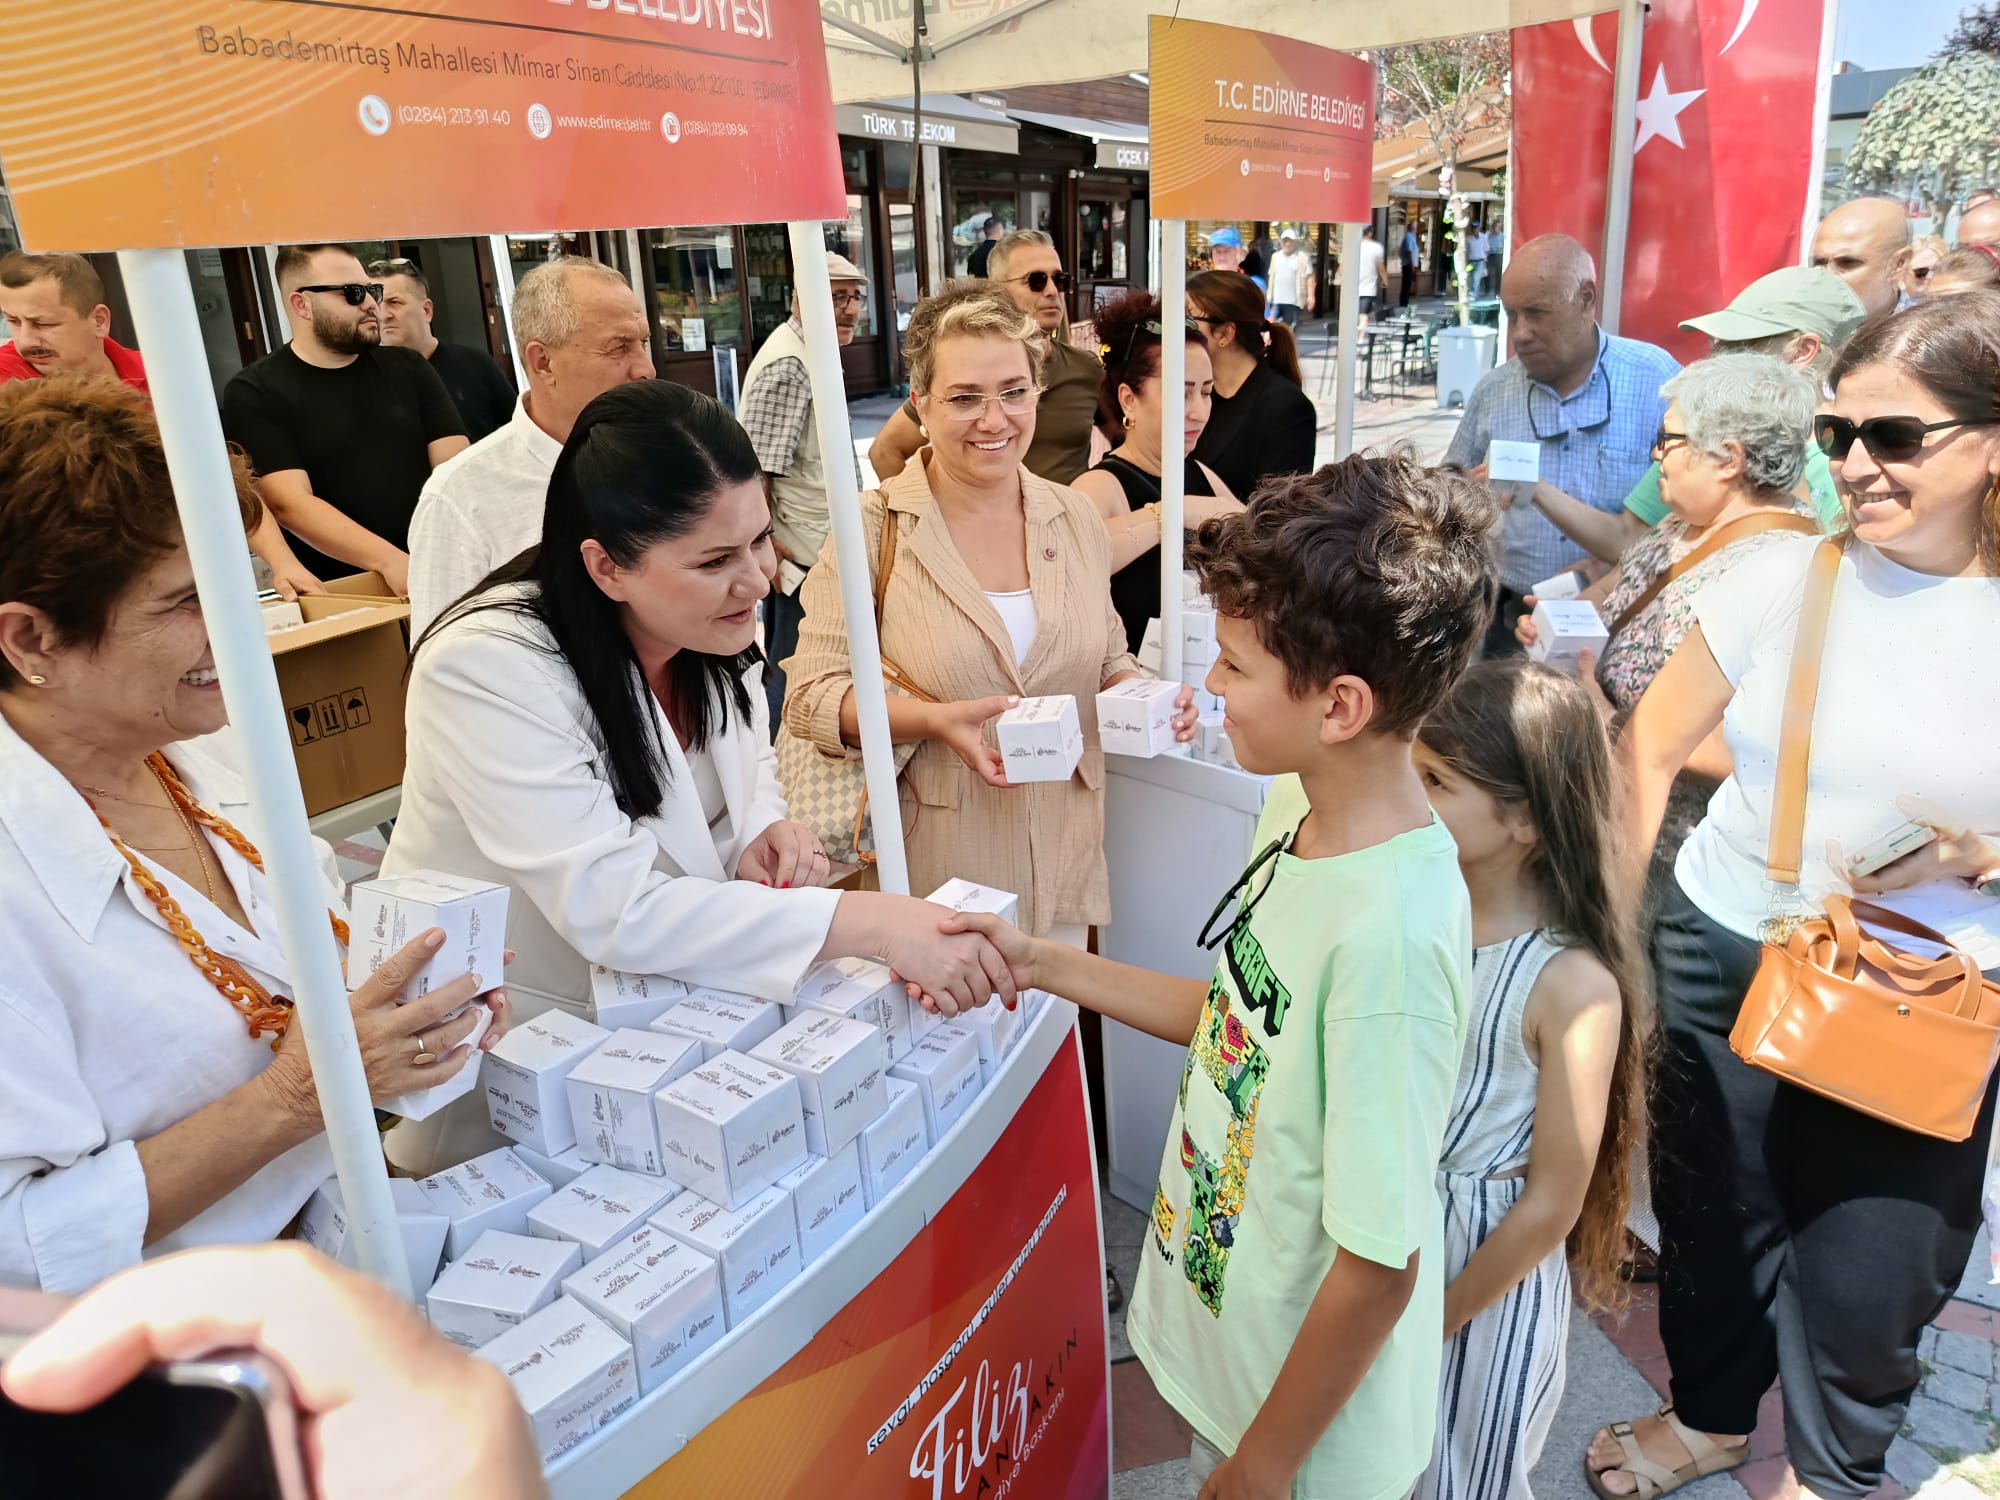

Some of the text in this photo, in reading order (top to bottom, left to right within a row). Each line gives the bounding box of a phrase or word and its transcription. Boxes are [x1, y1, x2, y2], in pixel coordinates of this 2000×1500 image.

[196, 25, 391, 74] Babademirtaş
[396, 41, 498, 76] Mahallesi
[503, 51, 560, 80] Mimar
[566, 57, 611, 85] Sinan
[614, 63, 673, 91] Caddesi
[398, 104, 511, 127] (0284) 213 91 40
[862, 112, 956, 143] TÜRK TEEKOM
[1215, 79, 1366, 130] T.C. EDİRNE BELEDİYESİ
[1030, 1327, 1078, 1425] AKIN
[909, 1358, 1033, 1500] Filiz
